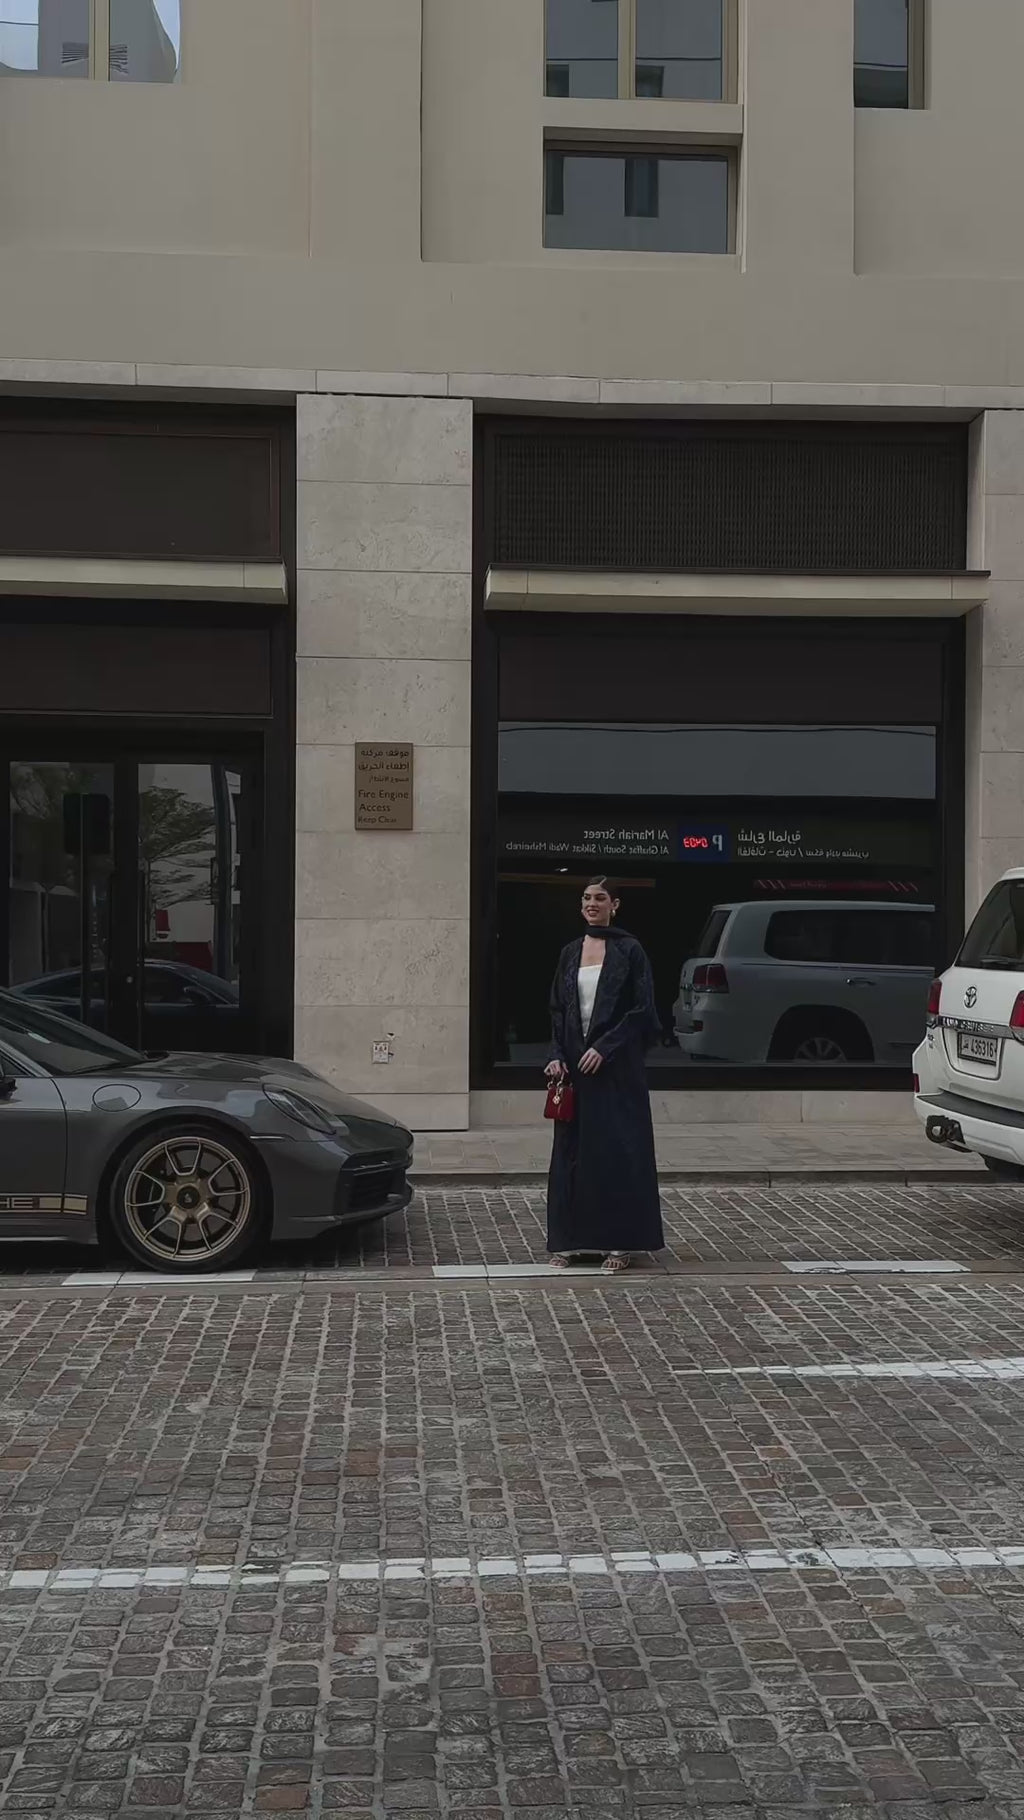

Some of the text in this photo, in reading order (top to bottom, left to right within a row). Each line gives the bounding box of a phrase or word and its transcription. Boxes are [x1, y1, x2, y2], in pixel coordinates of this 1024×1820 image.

[358, 789, 409, 801] Fire Engine
[359, 803, 391, 812] Access
